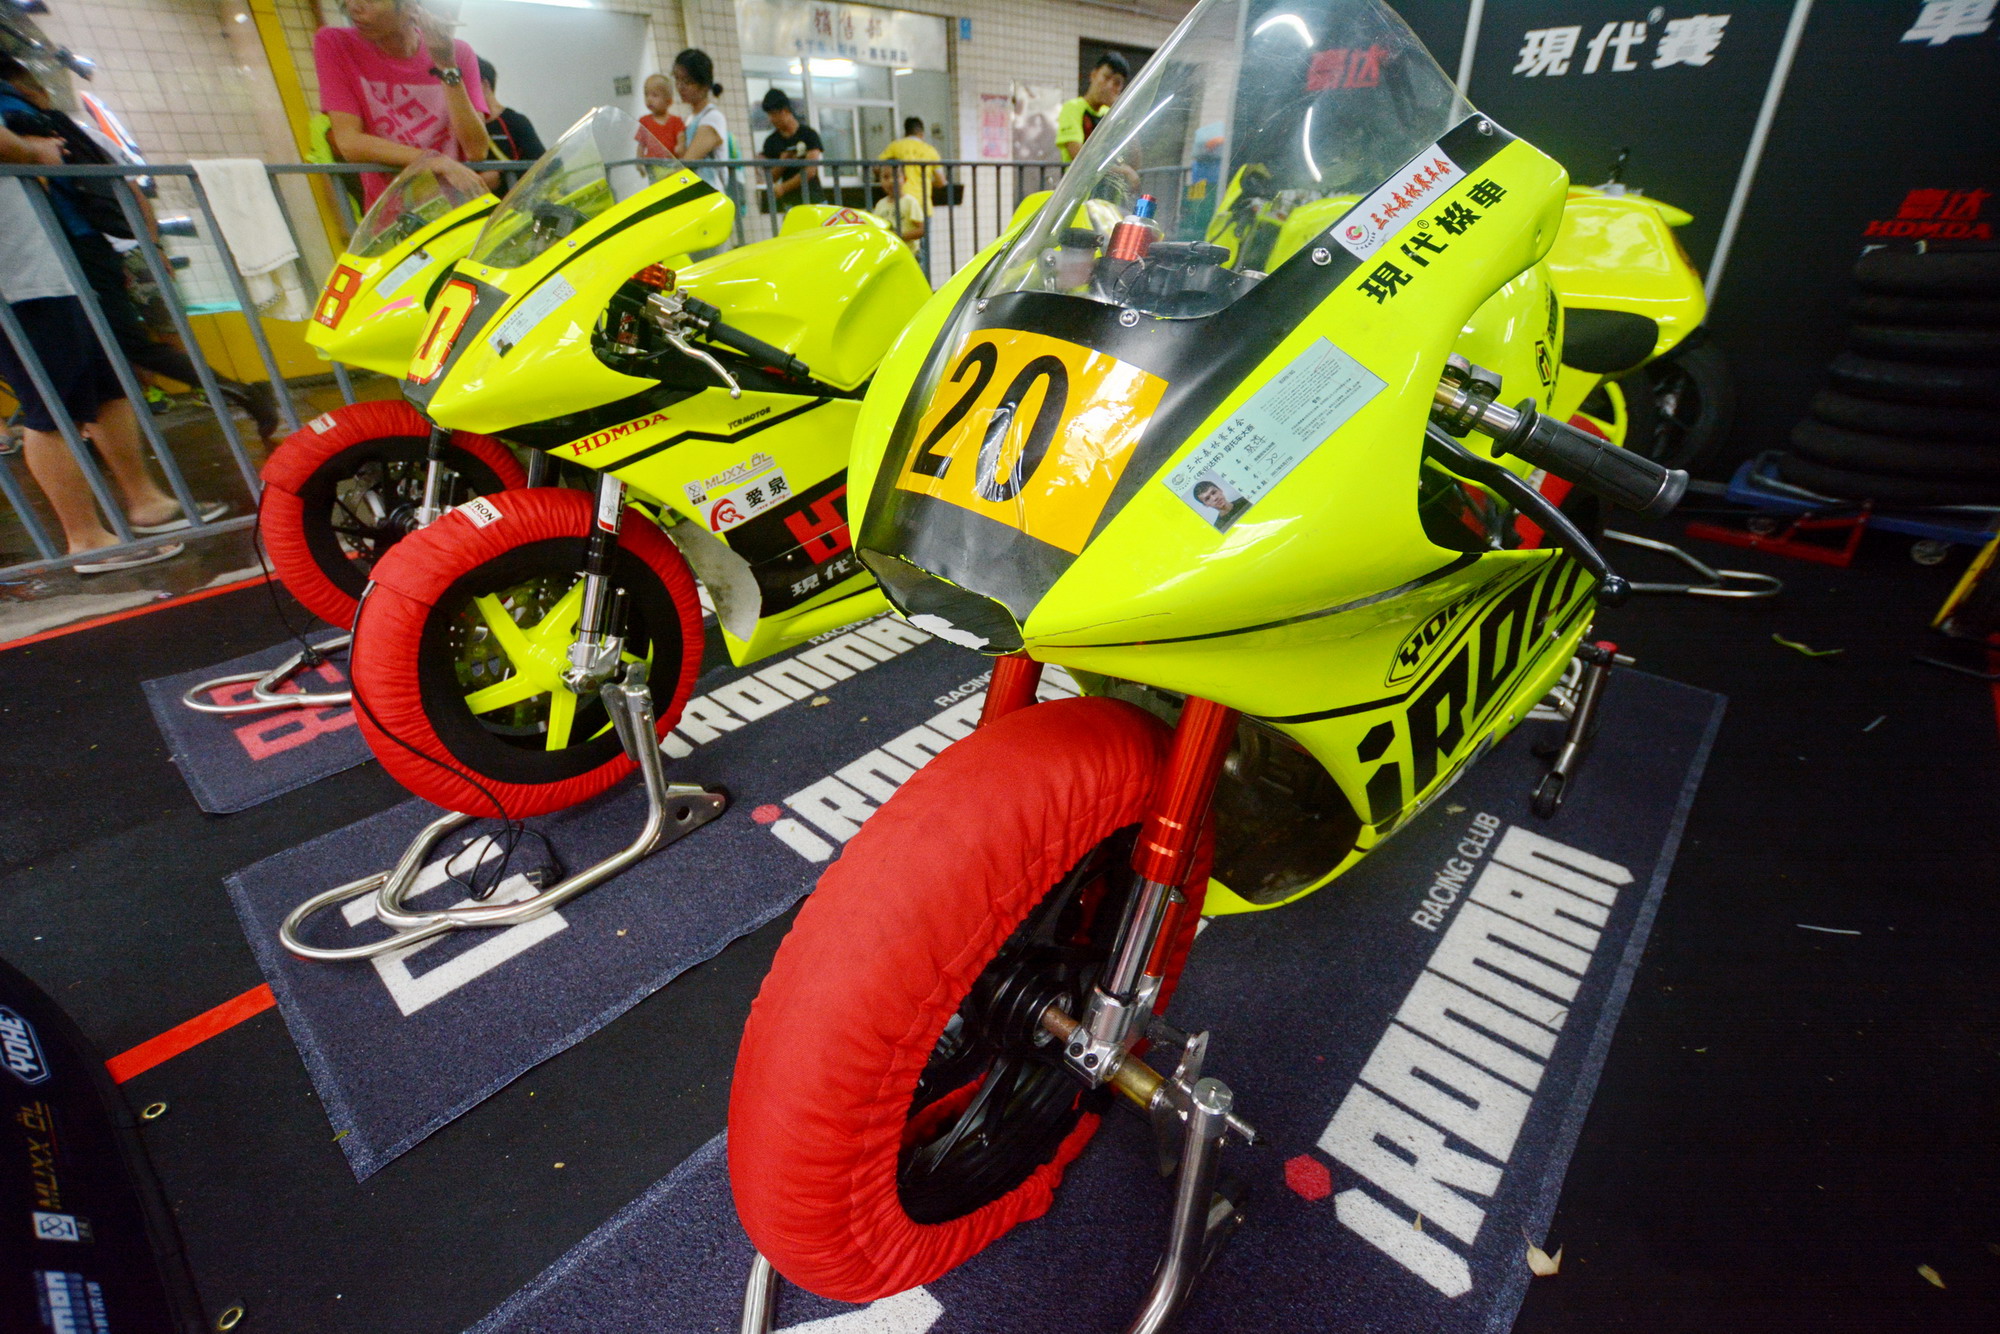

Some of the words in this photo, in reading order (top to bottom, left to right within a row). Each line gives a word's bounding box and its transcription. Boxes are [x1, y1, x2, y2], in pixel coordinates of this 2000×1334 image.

[570, 412, 672, 457] HDMDA
[910, 341, 1068, 502] 20
[704, 461, 746, 490] MUXX
[1411, 858, 1476, 933] RACING
[1456, 811, 1502, 862] CLUB
